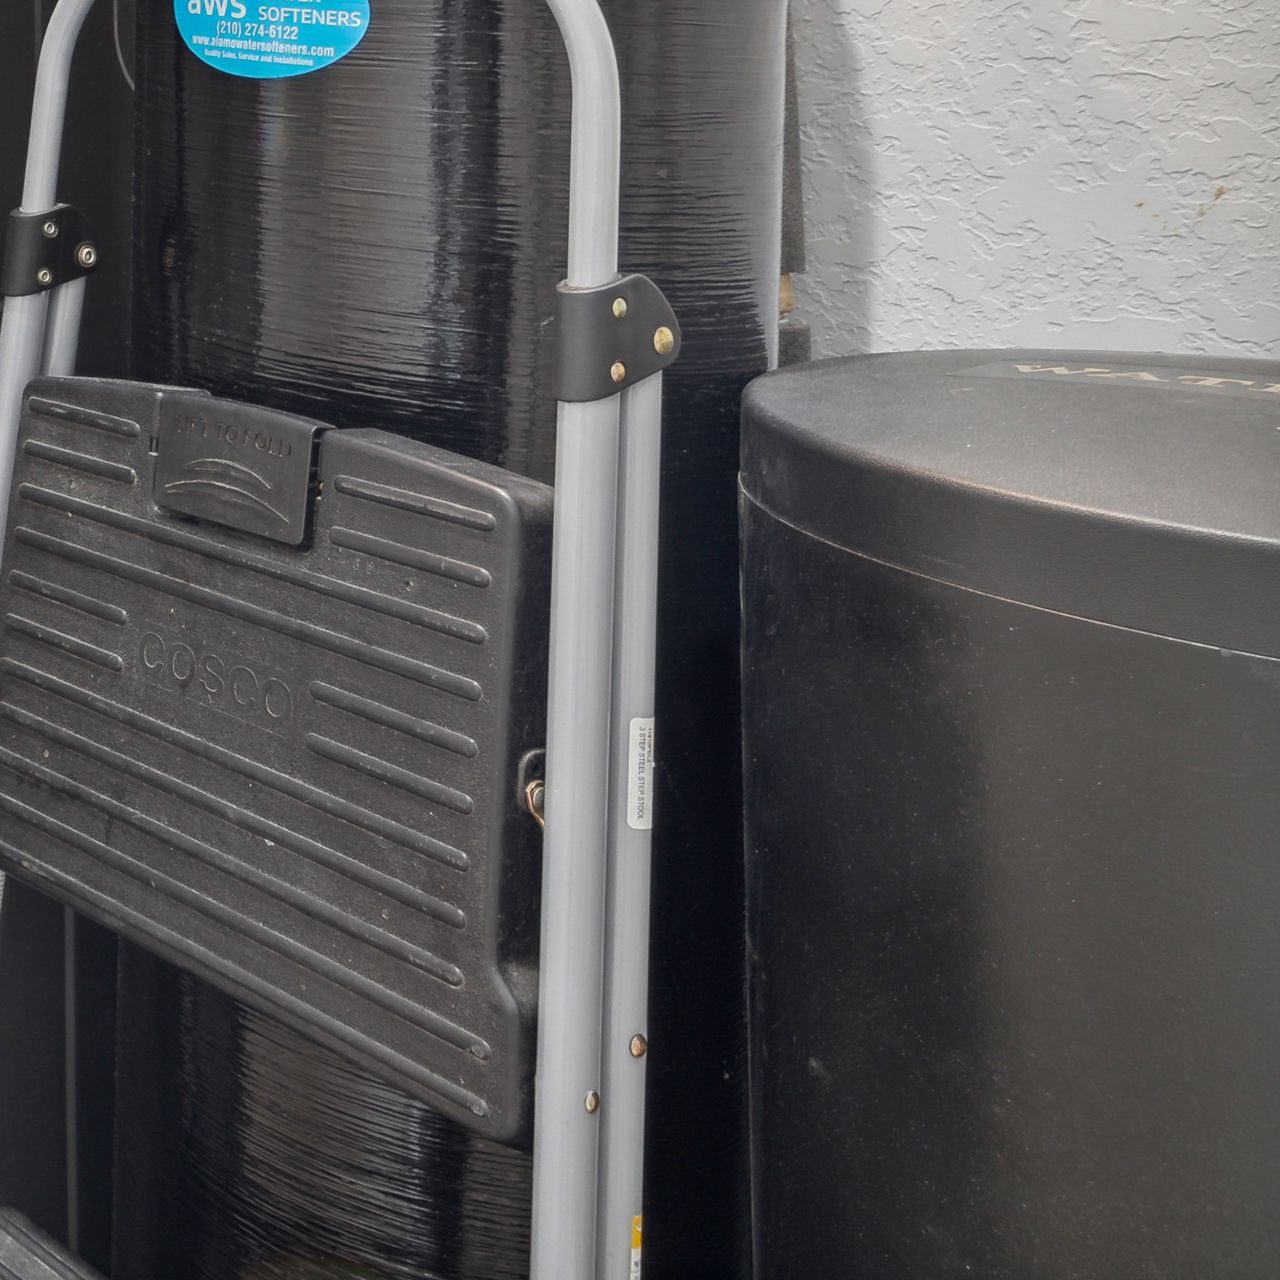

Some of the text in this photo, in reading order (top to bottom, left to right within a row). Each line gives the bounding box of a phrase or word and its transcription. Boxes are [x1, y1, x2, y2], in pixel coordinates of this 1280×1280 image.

[258, 6, 361, 27] SOFTENERS
[216, 21, 298, 40] (210) 274-6122
[192, 35, 334, 57] www.alamowatersofteners.com
[238, 52, 259, 62] Service
[260, 55, 272, 63] and
[215, 422, 238, 444] TO
[242, 428, 293, 458] FOLD
[638, 752, 646, 775] STEEL
[637, 776, 645, 796] STEP
[637, 797, 645, 821] STOOL
